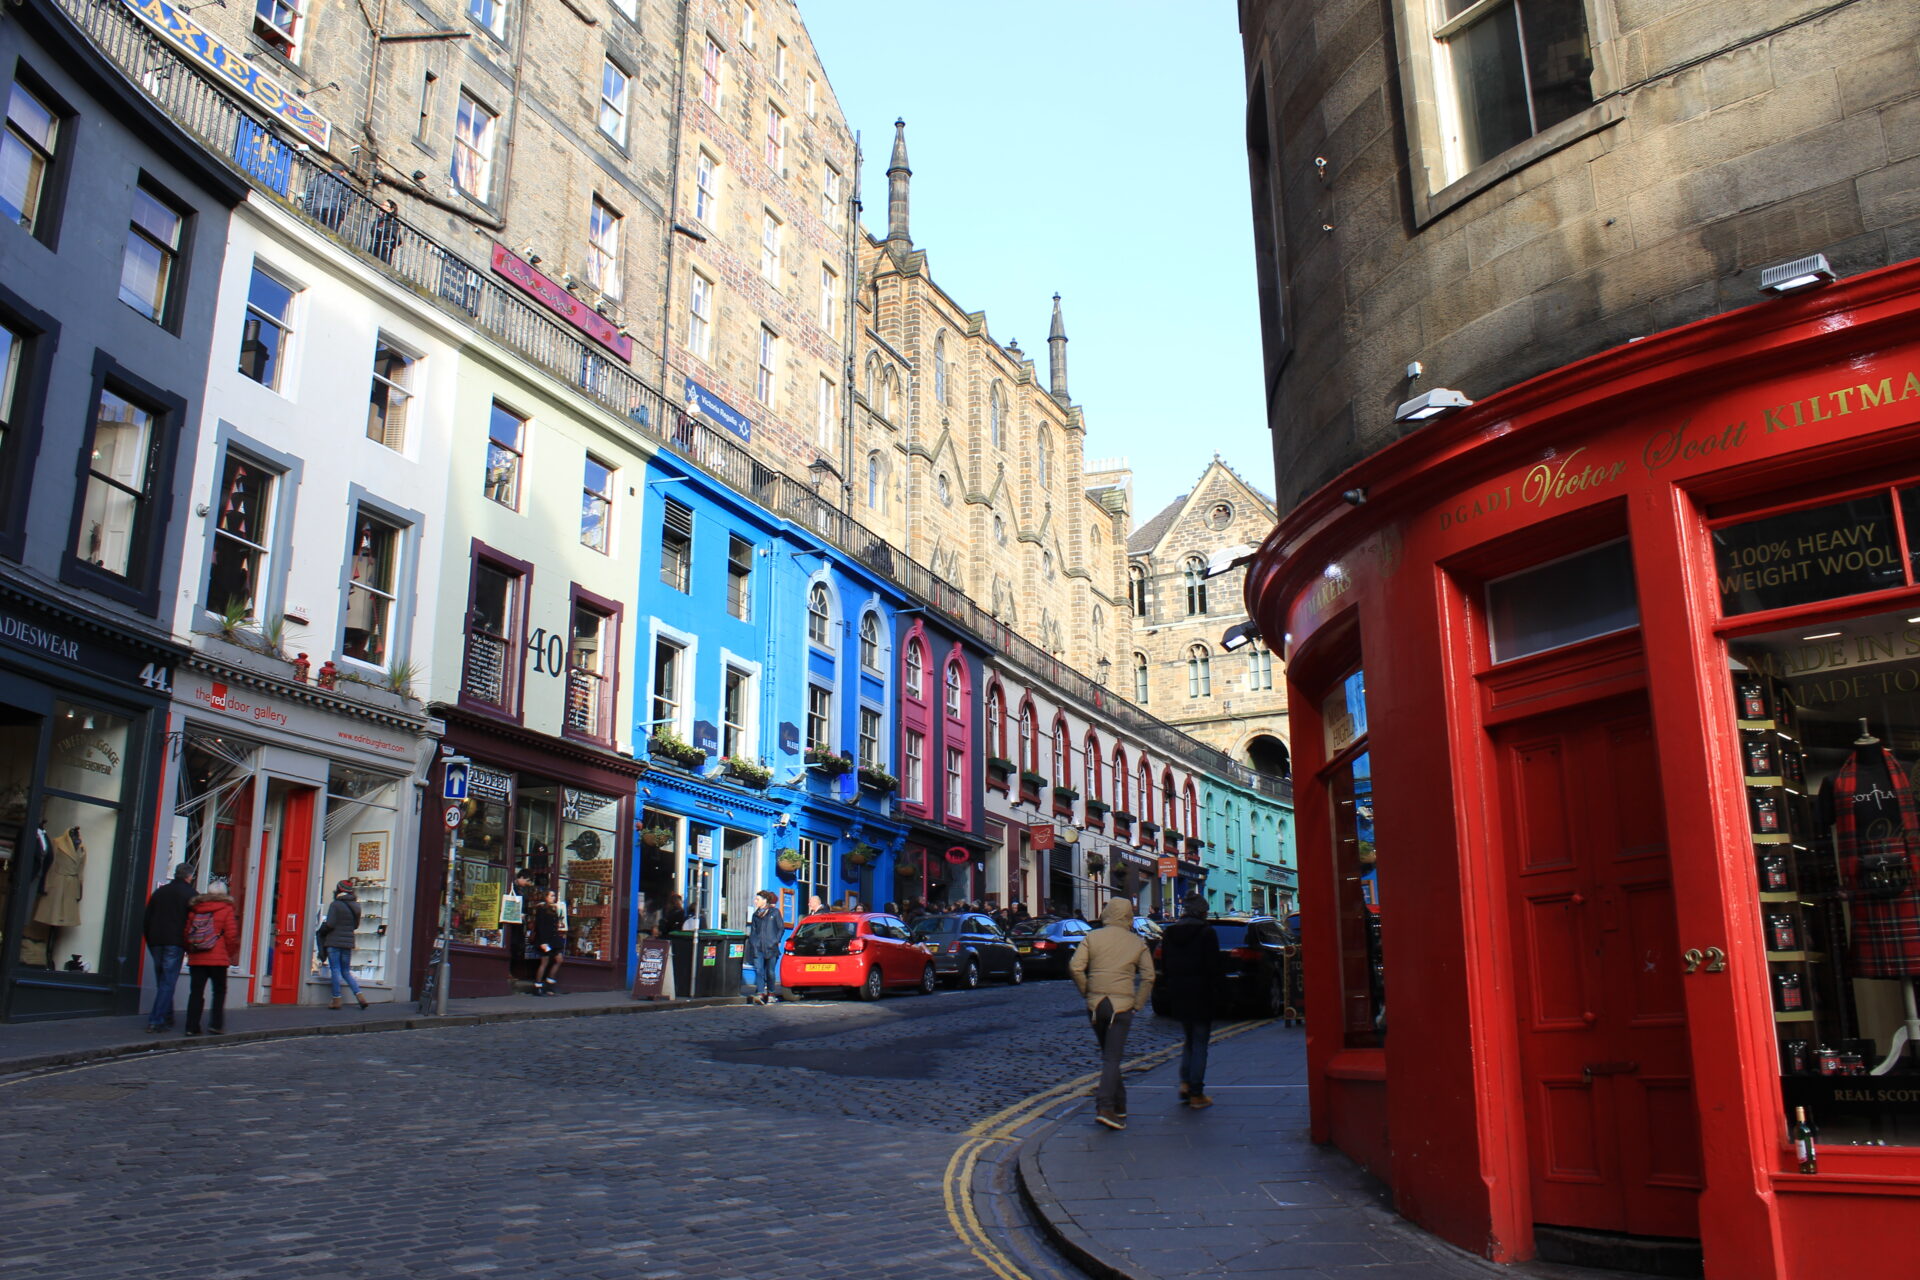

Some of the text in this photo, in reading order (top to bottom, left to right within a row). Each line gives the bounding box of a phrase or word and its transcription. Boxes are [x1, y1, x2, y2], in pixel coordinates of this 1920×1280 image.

[1521, 446, 1626, 507] Victor
[1641, 418, 1746, 479] Scott
[1729, 522, 1876, 569] 100% HEAVY
[1718, 545, 1899, 595] WEIGHT WOOL
[528, 627, 563, 678] 40
[1747, 640, 1847, 680] MADE
[1855, 631, 1894, 662] IN
[195, 687, 288, 725] the red door gallery
[1782, 674, 1870, 705] MADE
[337, 731, 405, 752] www.edinburghart.com
[446, 812, 459, 822] 20
[283, 937, 295, 947] 42
[1684, 946, 1726, 974] 92
[1834, 1089, 1874, 1101] REAL
